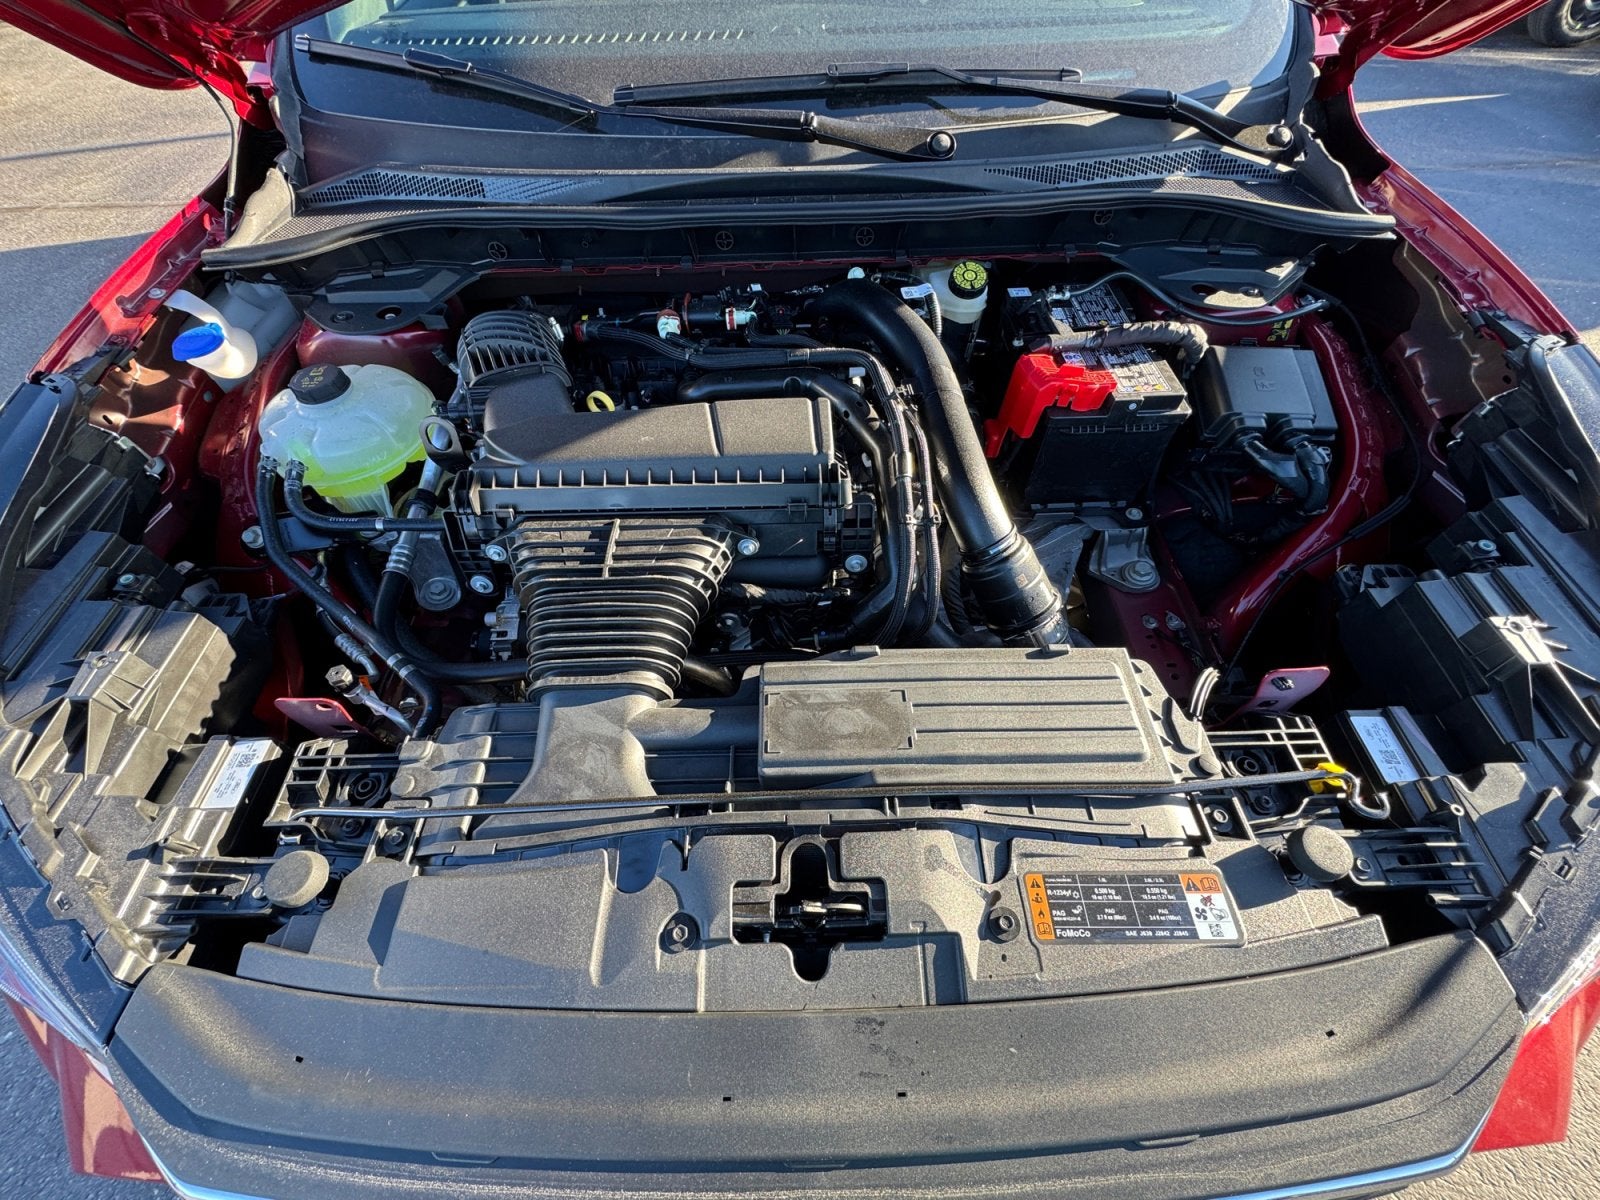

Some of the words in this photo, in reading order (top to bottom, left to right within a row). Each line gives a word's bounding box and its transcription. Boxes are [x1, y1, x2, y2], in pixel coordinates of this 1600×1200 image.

[1047, 889, 1072, 897] R-1234yf
[1108, 887, 1116, 895] kg
[1160, 887, 1168, 895] kg
[1055, 928, 1091, 938] FoMoCo
